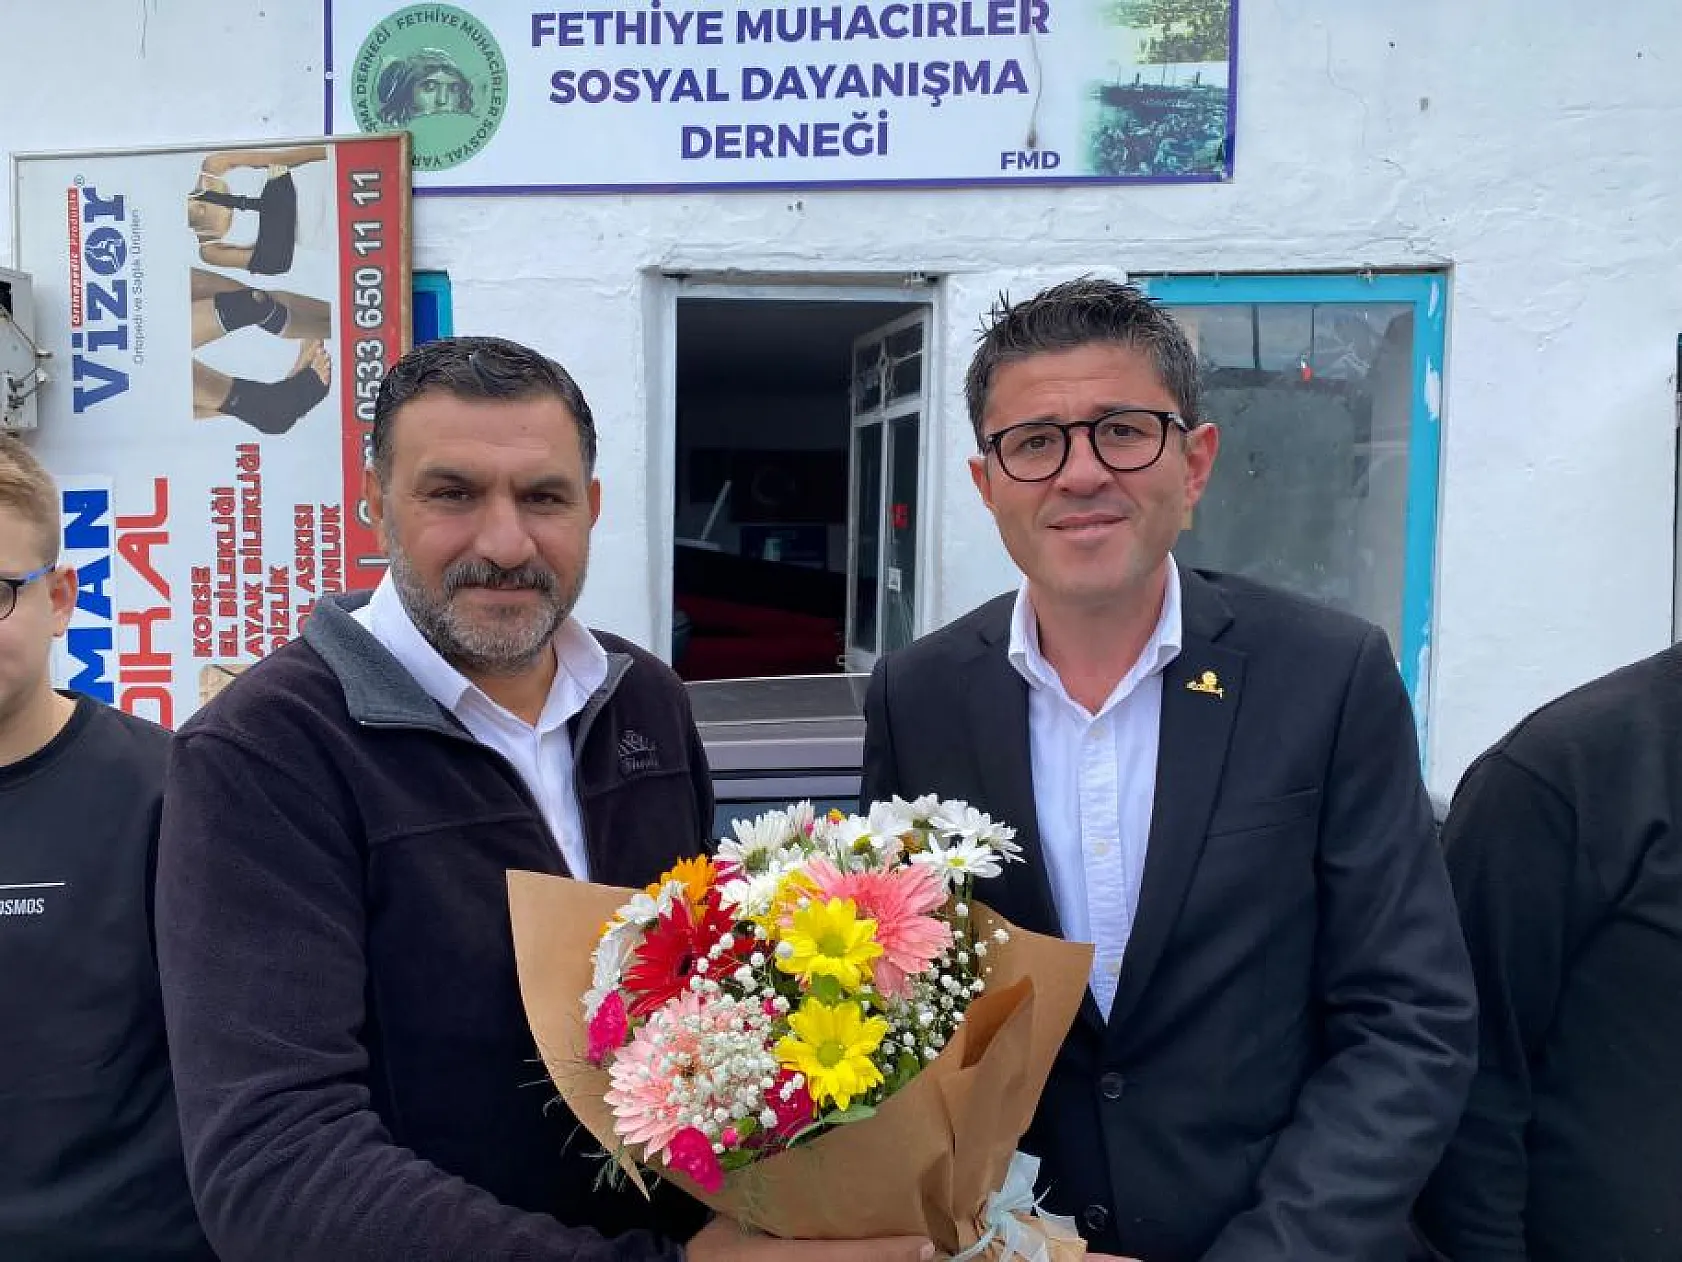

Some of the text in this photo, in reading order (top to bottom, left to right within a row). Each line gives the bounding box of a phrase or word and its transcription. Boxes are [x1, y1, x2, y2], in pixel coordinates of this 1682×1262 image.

[531, 0, 724, 47] FETHİYE
[549, 59, 1029, 107] SOSYAL DAYANIŞMA
[680, 109, 889, 160] DERNEĞİ
[1000, 150, 1061, 170] FMD
[351, 171, 381, 206] 11
[352, 220, 382, 255] 11
[71, 187, 130, 413] Vizor
[354, 267, 383, 329] 650
[211, 487, 238, 657] EL BİLEKLİĞİ
[236, 443, 264, 657] AYAK BİLEKLİĞİ
[294, 503, 315, 593] ASKISI
[191, 566, 212, 657] KORSE
[265, 566, 290, 650] DİZLİK
